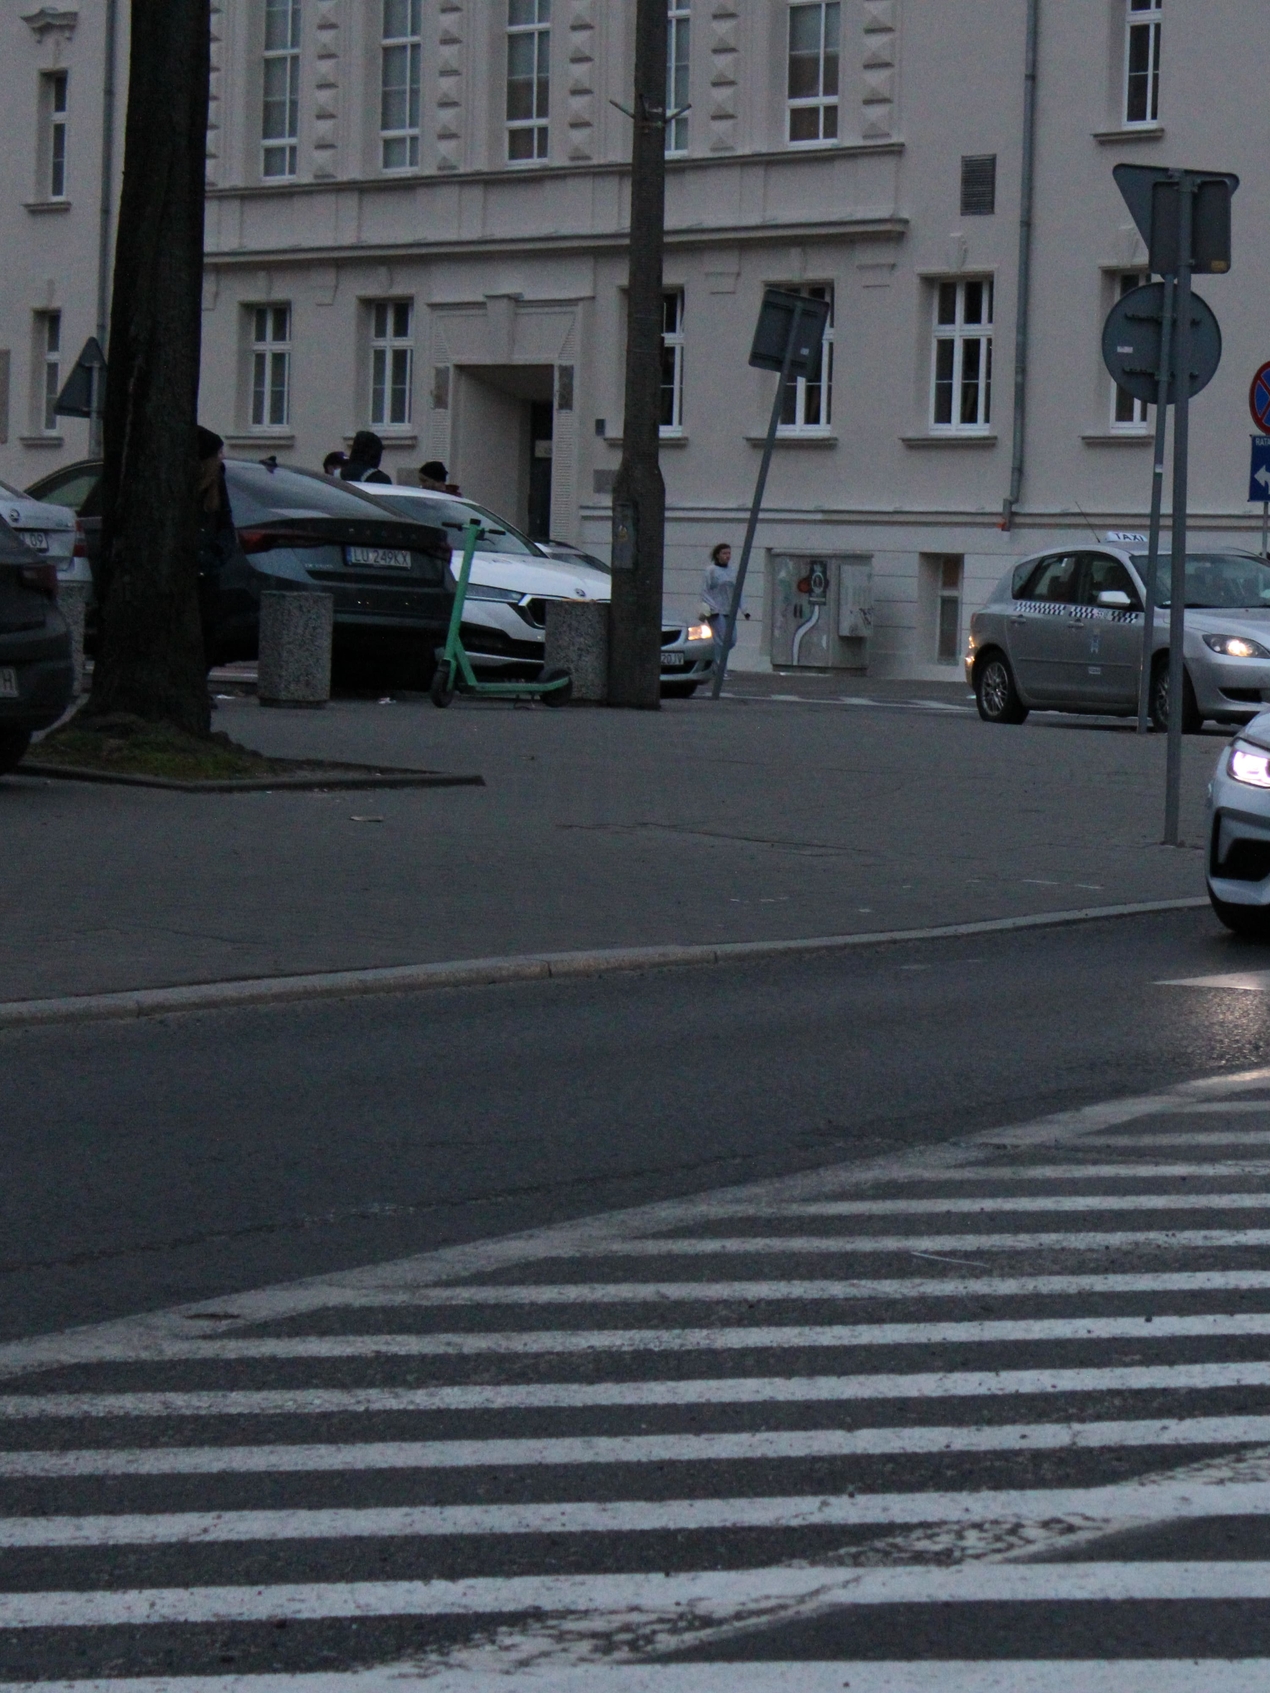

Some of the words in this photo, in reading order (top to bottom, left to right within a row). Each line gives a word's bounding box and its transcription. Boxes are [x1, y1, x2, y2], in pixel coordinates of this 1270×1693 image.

[1114, 532, 1145, 542] TAXI
[354, 549, 369, 563] LU
[373, 550, 408, 566] 249KX
